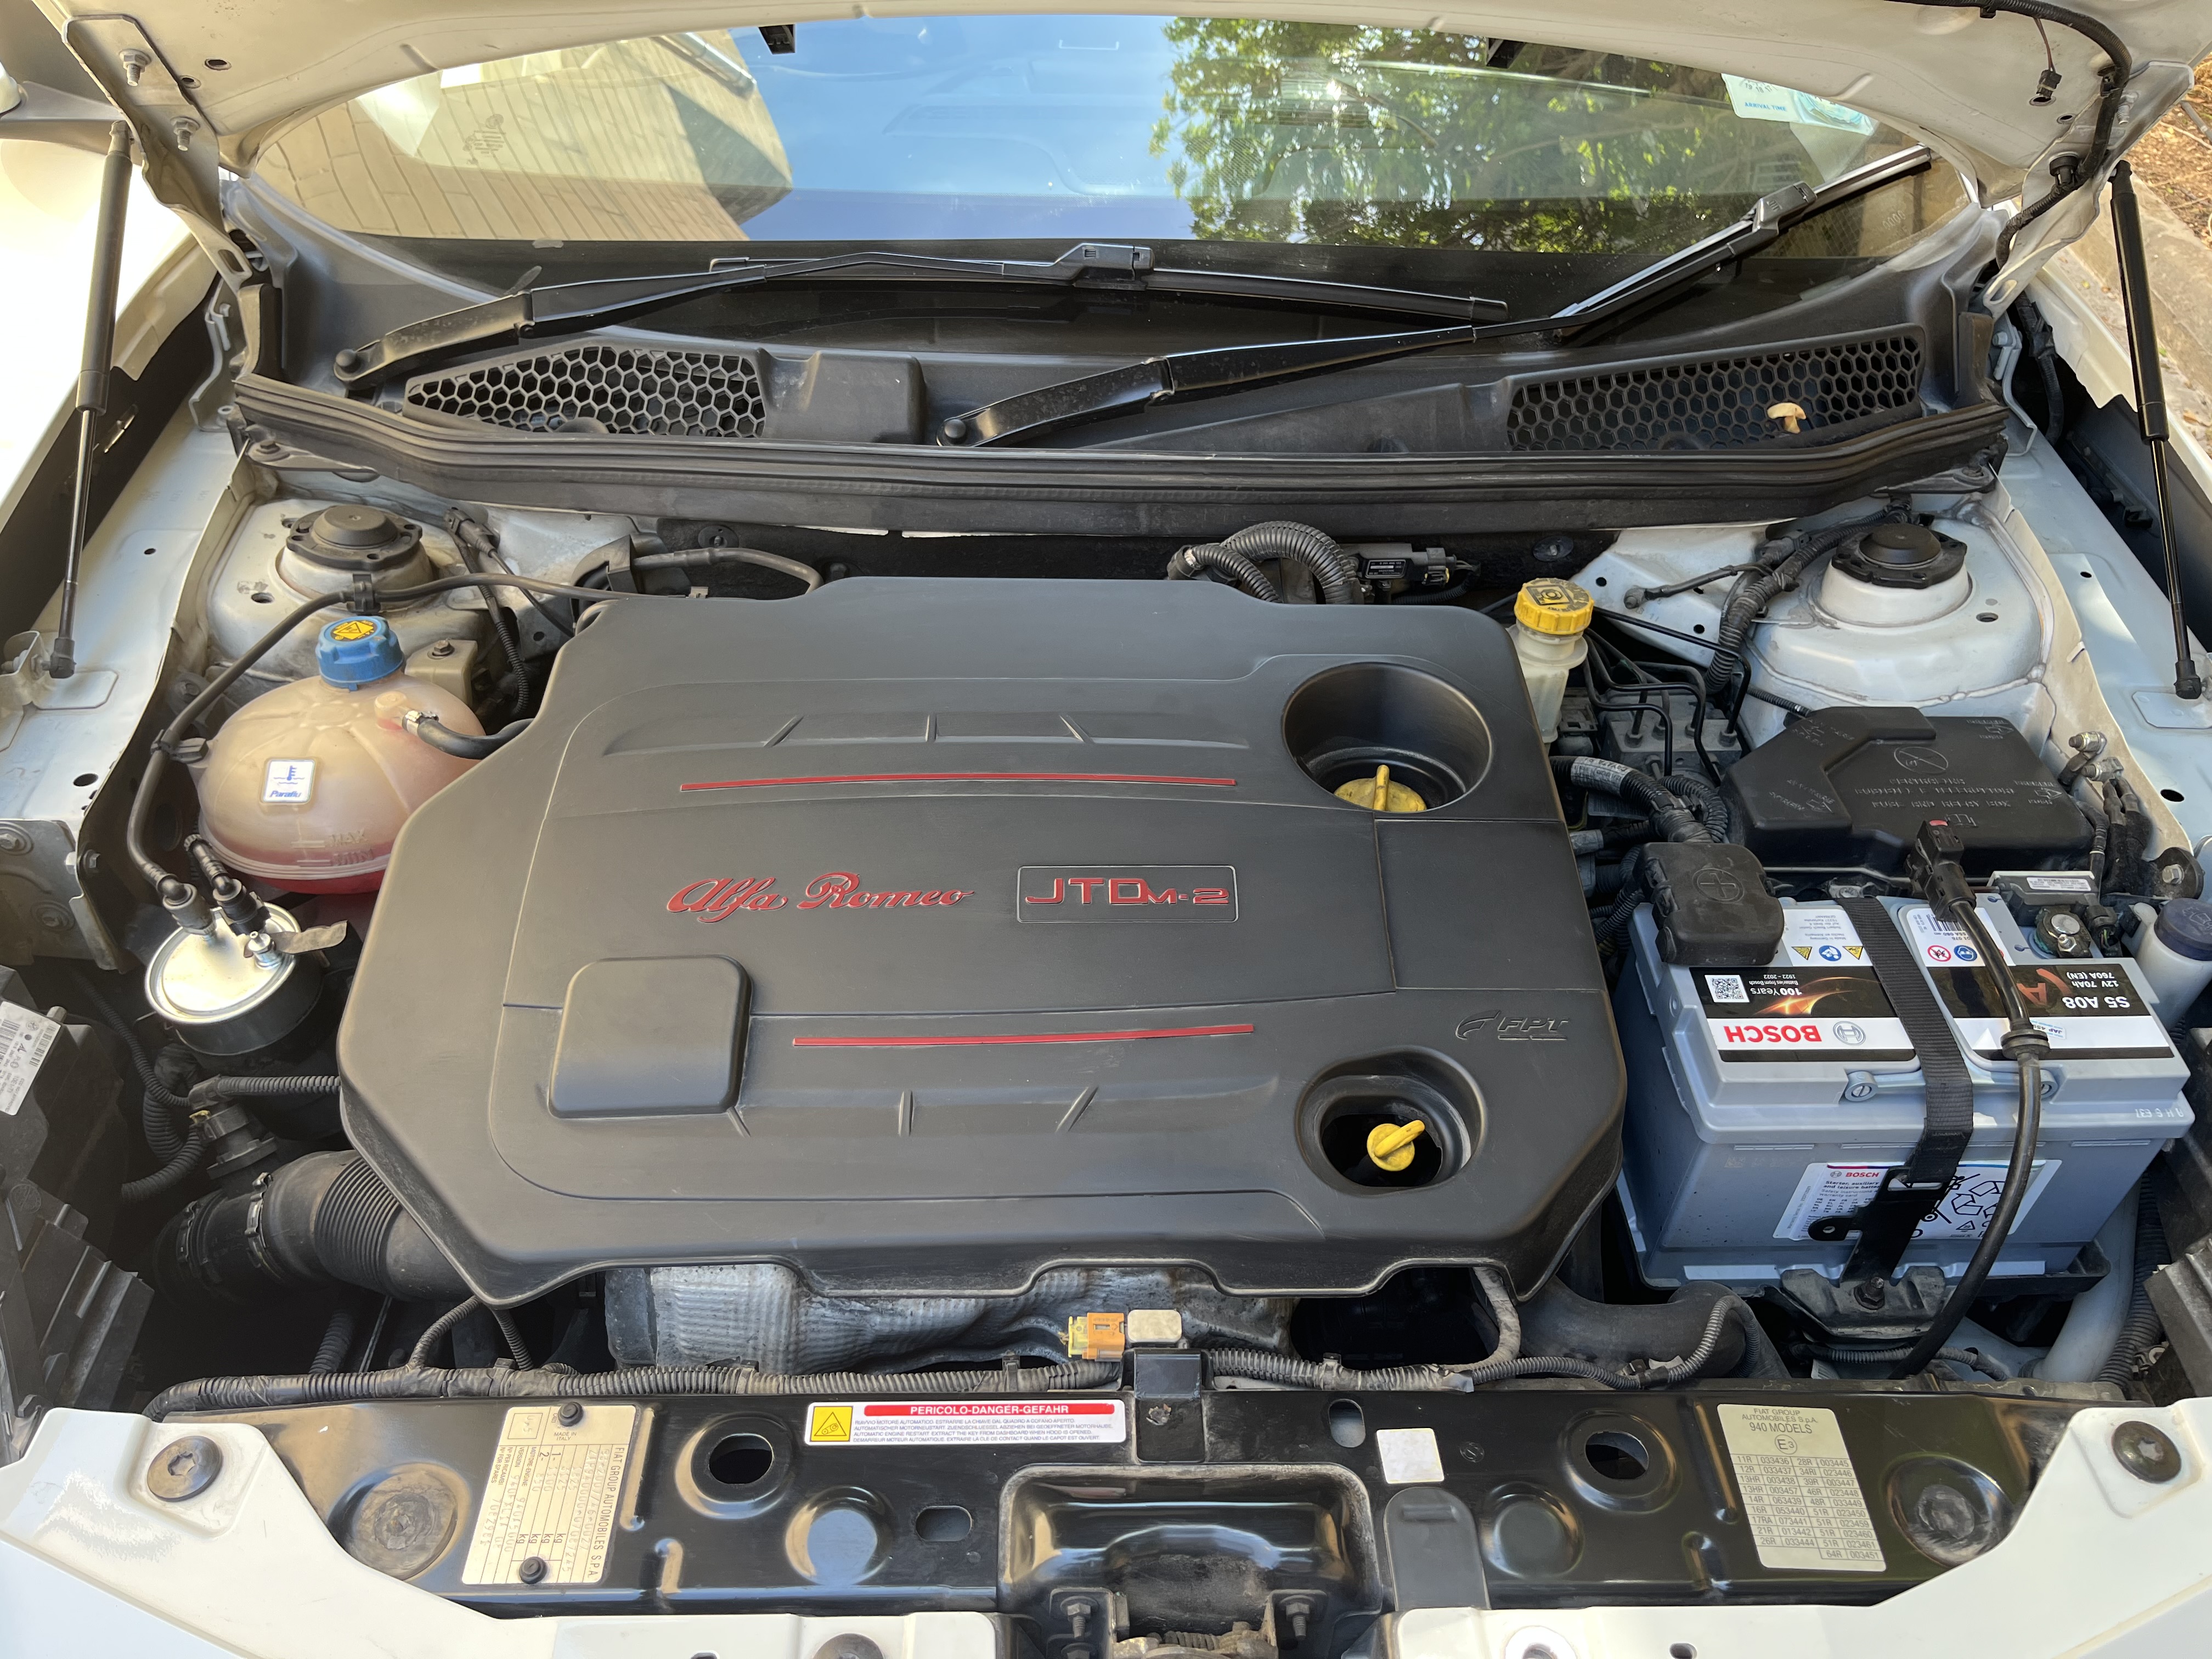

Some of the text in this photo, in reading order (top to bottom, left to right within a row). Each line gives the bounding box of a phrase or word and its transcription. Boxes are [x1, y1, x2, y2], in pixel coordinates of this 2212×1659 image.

[666, 871, 974, 923] Alfa Romeo
[2066, 972, 2088, 980] (EN)
[1750, 988, 1802, 996] 100 Years
[2062, 996, 2130, 1008] S5 A08
[1497, 1017, 1571, 1032] FPT
[1723, 1025, 1822, 1043] BOSCH
[910, 1405, 1069, 1415] PERICOLO-DANGER-GEFAHR
[1750, 1422, 1813, 1434] 940 MODELS
[515, 1447, 525, 1468] VERSION
[613, 1447, 625, 1463] FIAT
[521, 1447, 537, 1487] MOTORE-ENGINE
[1760, 1457, 1790, 1465] 033436
[1820, 1459, 1849, 1468] 003445
[491, 1464, 501, 1483] SPARES
[498, 1464, 509, 1485] RICAMBI
[607, 1465, 621, 1492] GROUP
[1823, 1469, 1852, 1477] 023446
[1740, 1475, 1760, 1483] 13HR
[1767, 1476, 1796, 1485] 003438
[1826, 1479, 1855, 1487] 003447
[1743, 1485, 1764, 1493] 13HR
[1770, 1486, 1798, 1494] 003457
[1830, 1488, 1859, 1497] 023448
[1748, 1496, 1863, 1508] 14R 063439 48R 033449
[1775, 1506, 1805, 1515] 053440
[1813, 1508, 1829, 1516] 51R
[1837, 1509, 1865, 1518] 023450
[593, 1494, 614, 1550] AUTOMOBILES
[1752, 1516, 1870, 1528] 17RA 073441 51R 023459
[1757, 1526, 1773, 1534] 21R
[1782, 1527, 1812, 1536] 013442
[1843, 1530, 1873, 1538] 023460
[516, 1533, 529, 1544] kg
[528, 1533, 541, 1544] kg
[541, 1533, 554, 1544] kg
[554, 1533, 566, 1544] kg
[1760, 1537, 1876, 1549] 26R 033444 51R 023461
[1826, 1550, 1880, 1560] 64R 003451
